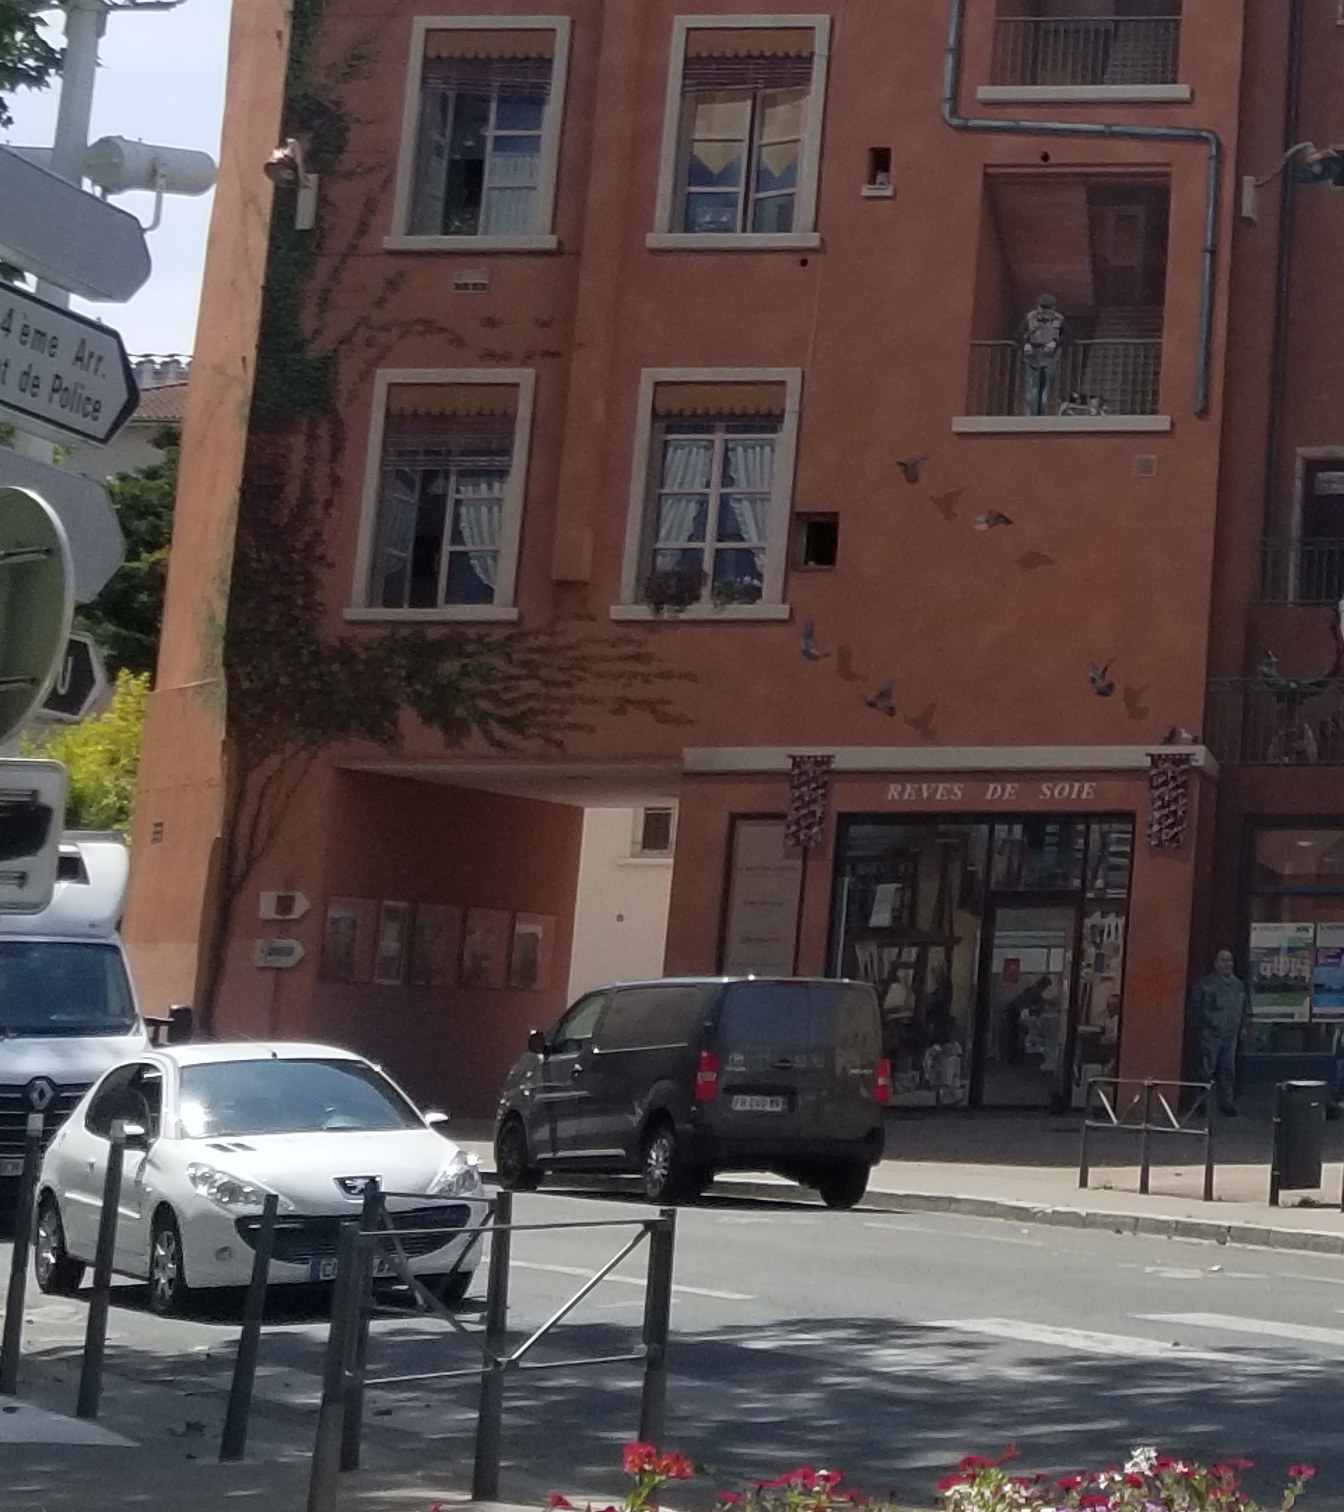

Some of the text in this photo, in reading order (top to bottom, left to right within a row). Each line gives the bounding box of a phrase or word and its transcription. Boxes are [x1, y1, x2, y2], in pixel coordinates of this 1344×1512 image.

[71, 338, 107, 379] Arr.
[48, 373, 102, 422] Police
[887, 782, 1097, 801] REVES DE SOIE
